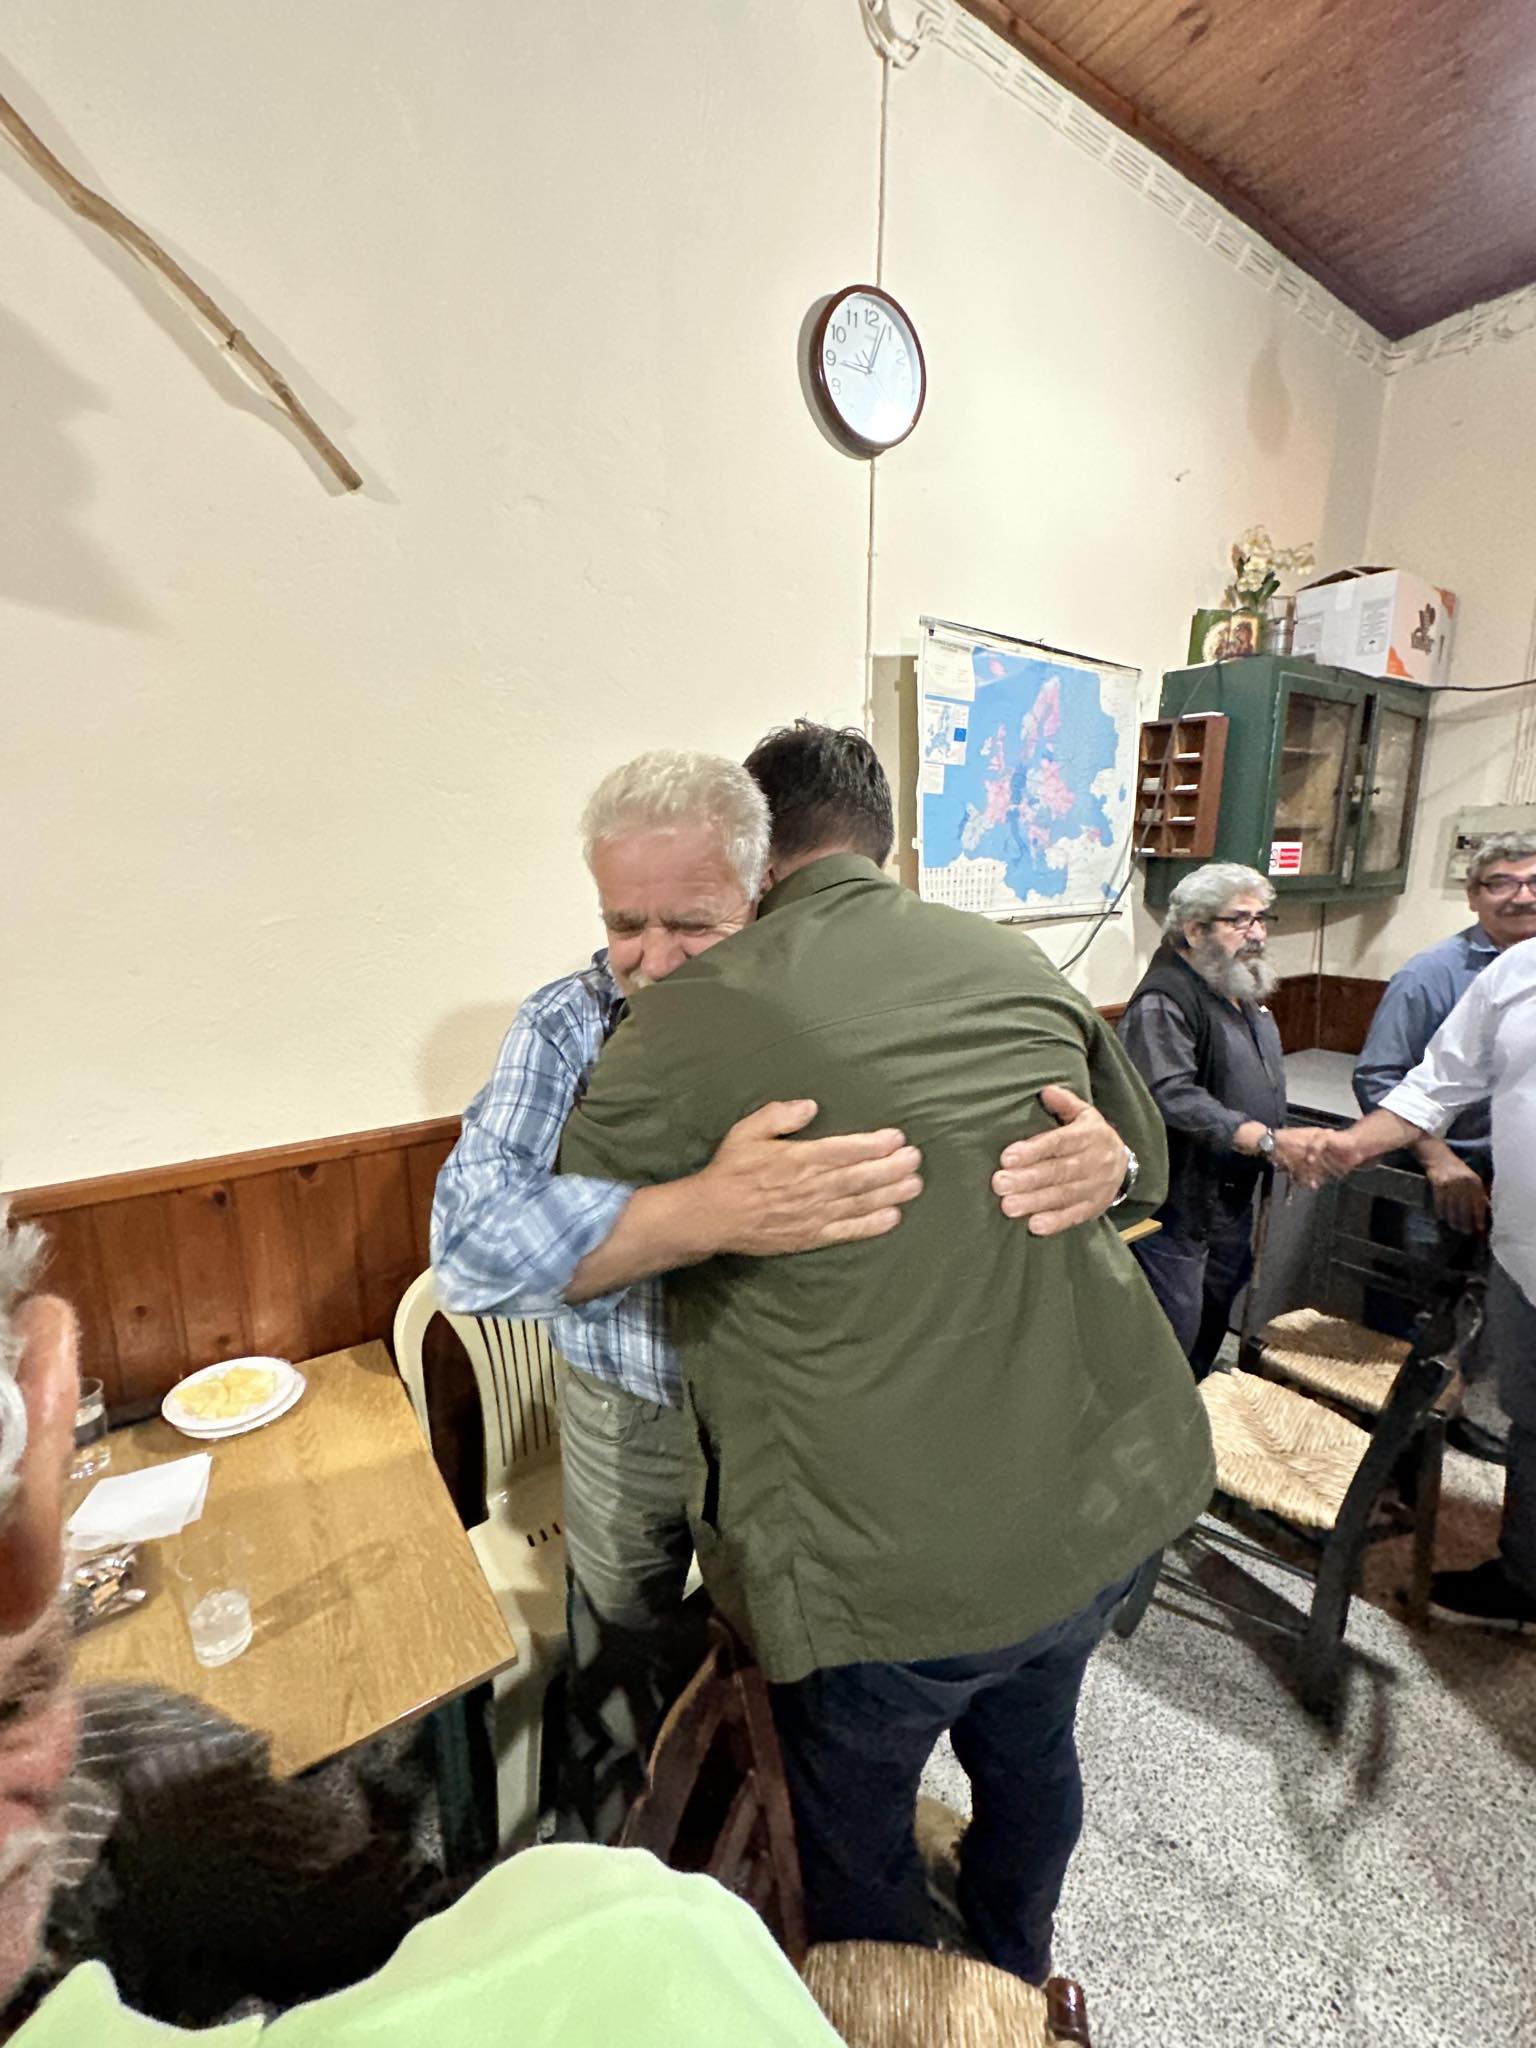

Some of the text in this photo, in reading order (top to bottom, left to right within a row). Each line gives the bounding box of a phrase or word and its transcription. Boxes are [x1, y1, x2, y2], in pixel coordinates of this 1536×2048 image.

[846, 308, 858, 328] 11
[864, 308, 880, 328] 12
[831, 323, 847, 343] 10
[825, 349, 837, 366] 9
[896, 349, 907, 366] 2
[831, 377, 842, 396] 8
